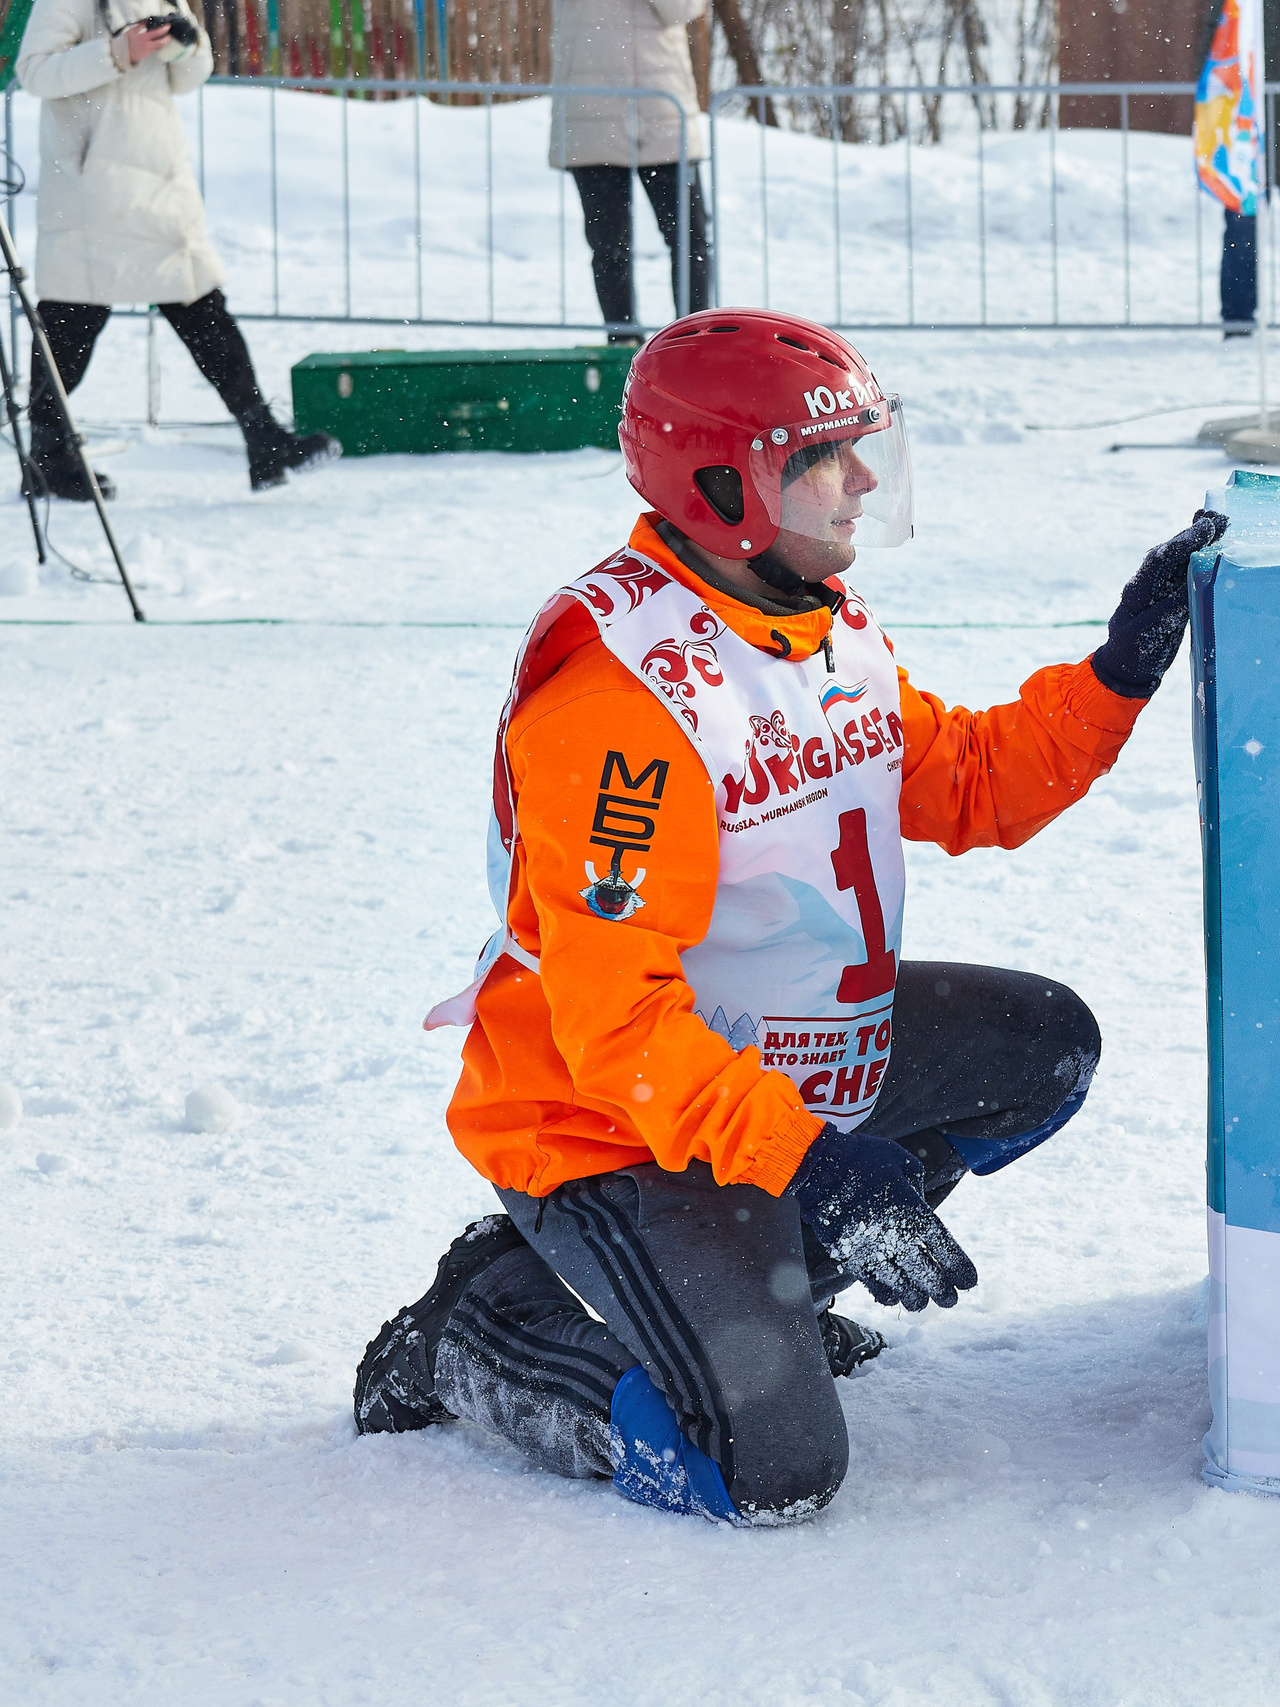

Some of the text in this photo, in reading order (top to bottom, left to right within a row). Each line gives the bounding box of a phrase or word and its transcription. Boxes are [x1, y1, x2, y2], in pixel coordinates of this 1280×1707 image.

[800, 415, 860, 436] МУРМАНСК
[589, 750, 670, 880] МБТ
[719, 787, 829, 833] RUSSIA, MURMANSK REGION
[831, 807, 896, 1003] 1
[763, 1049, 847, 1067] КТО ЗНАЕТ
[764, 1031, 849, 1050] ДЛЯ ТЕХ,
[798, 1057, 889, 1106] СНЕ
